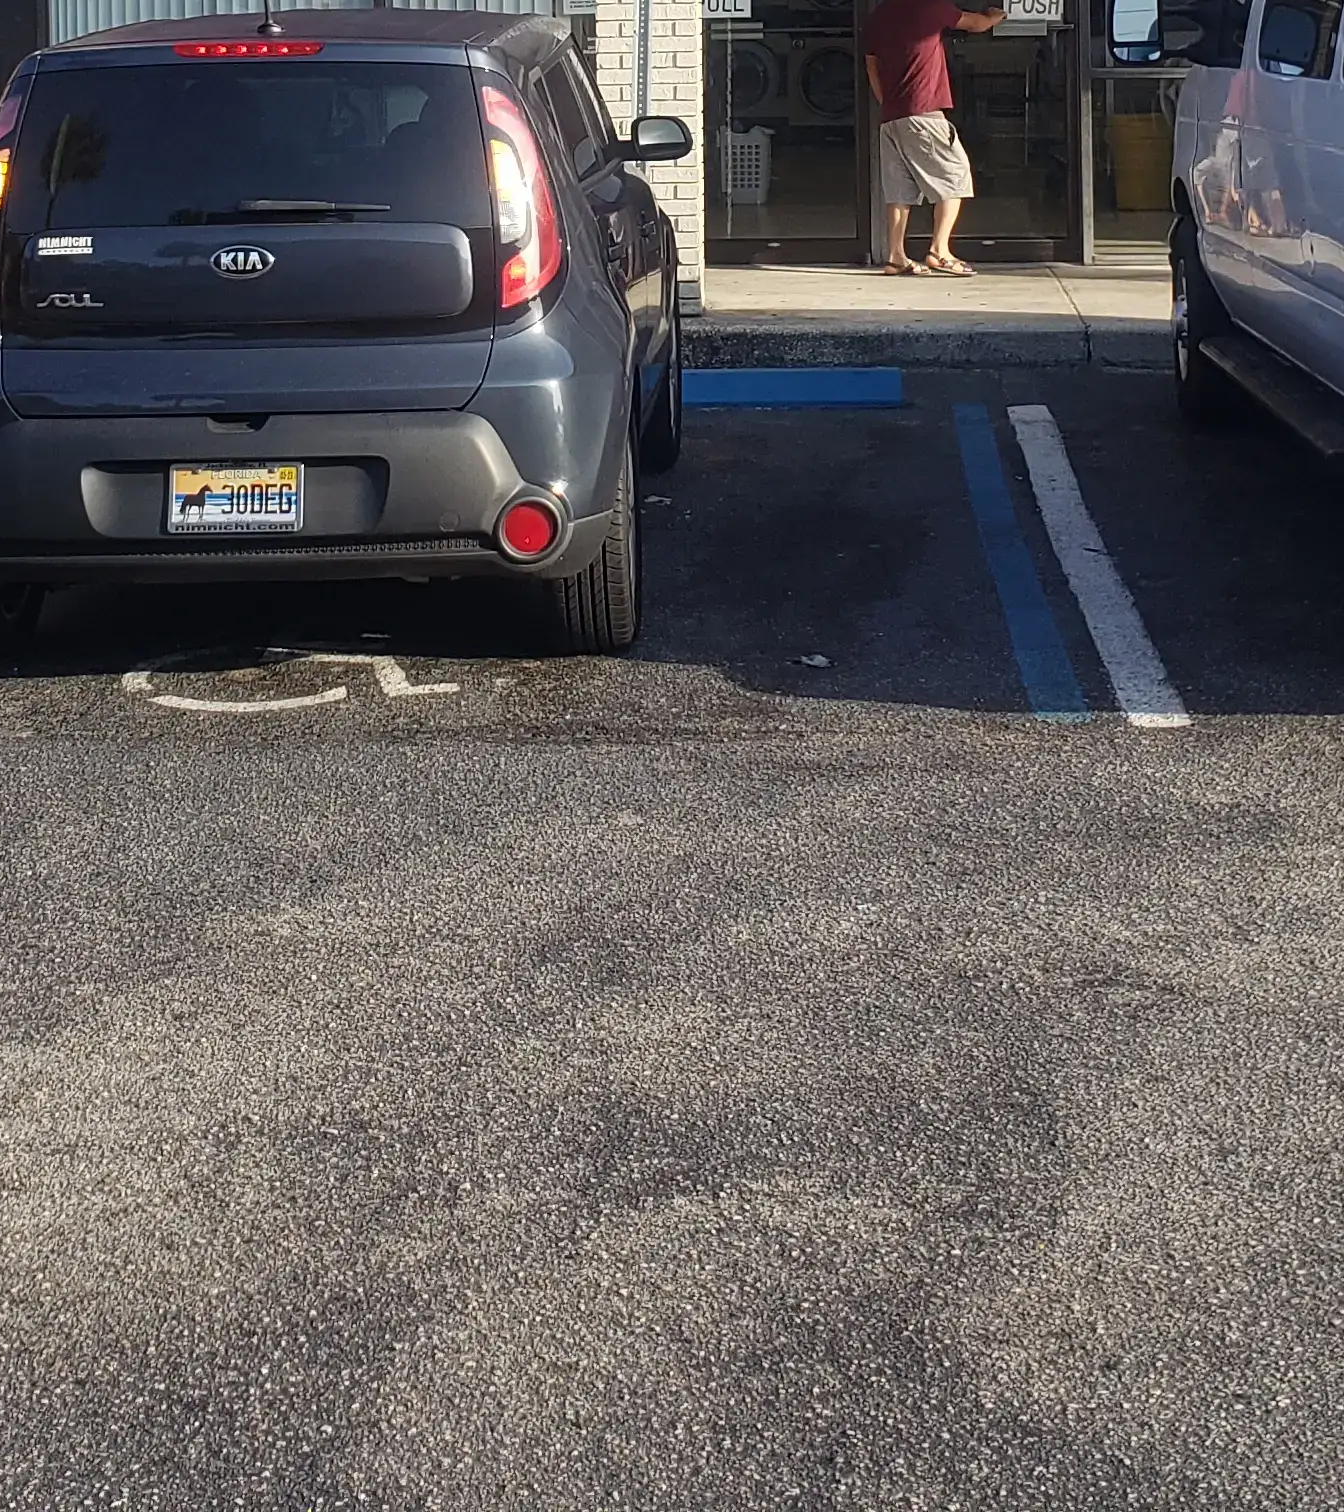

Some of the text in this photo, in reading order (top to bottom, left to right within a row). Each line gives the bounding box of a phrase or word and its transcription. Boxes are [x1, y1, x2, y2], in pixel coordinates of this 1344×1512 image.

[220, 251, 263, 271] KIA
[211, 470, 262, 480] FLORIDA
[175, 521, 296, 532] nimnicht.com
